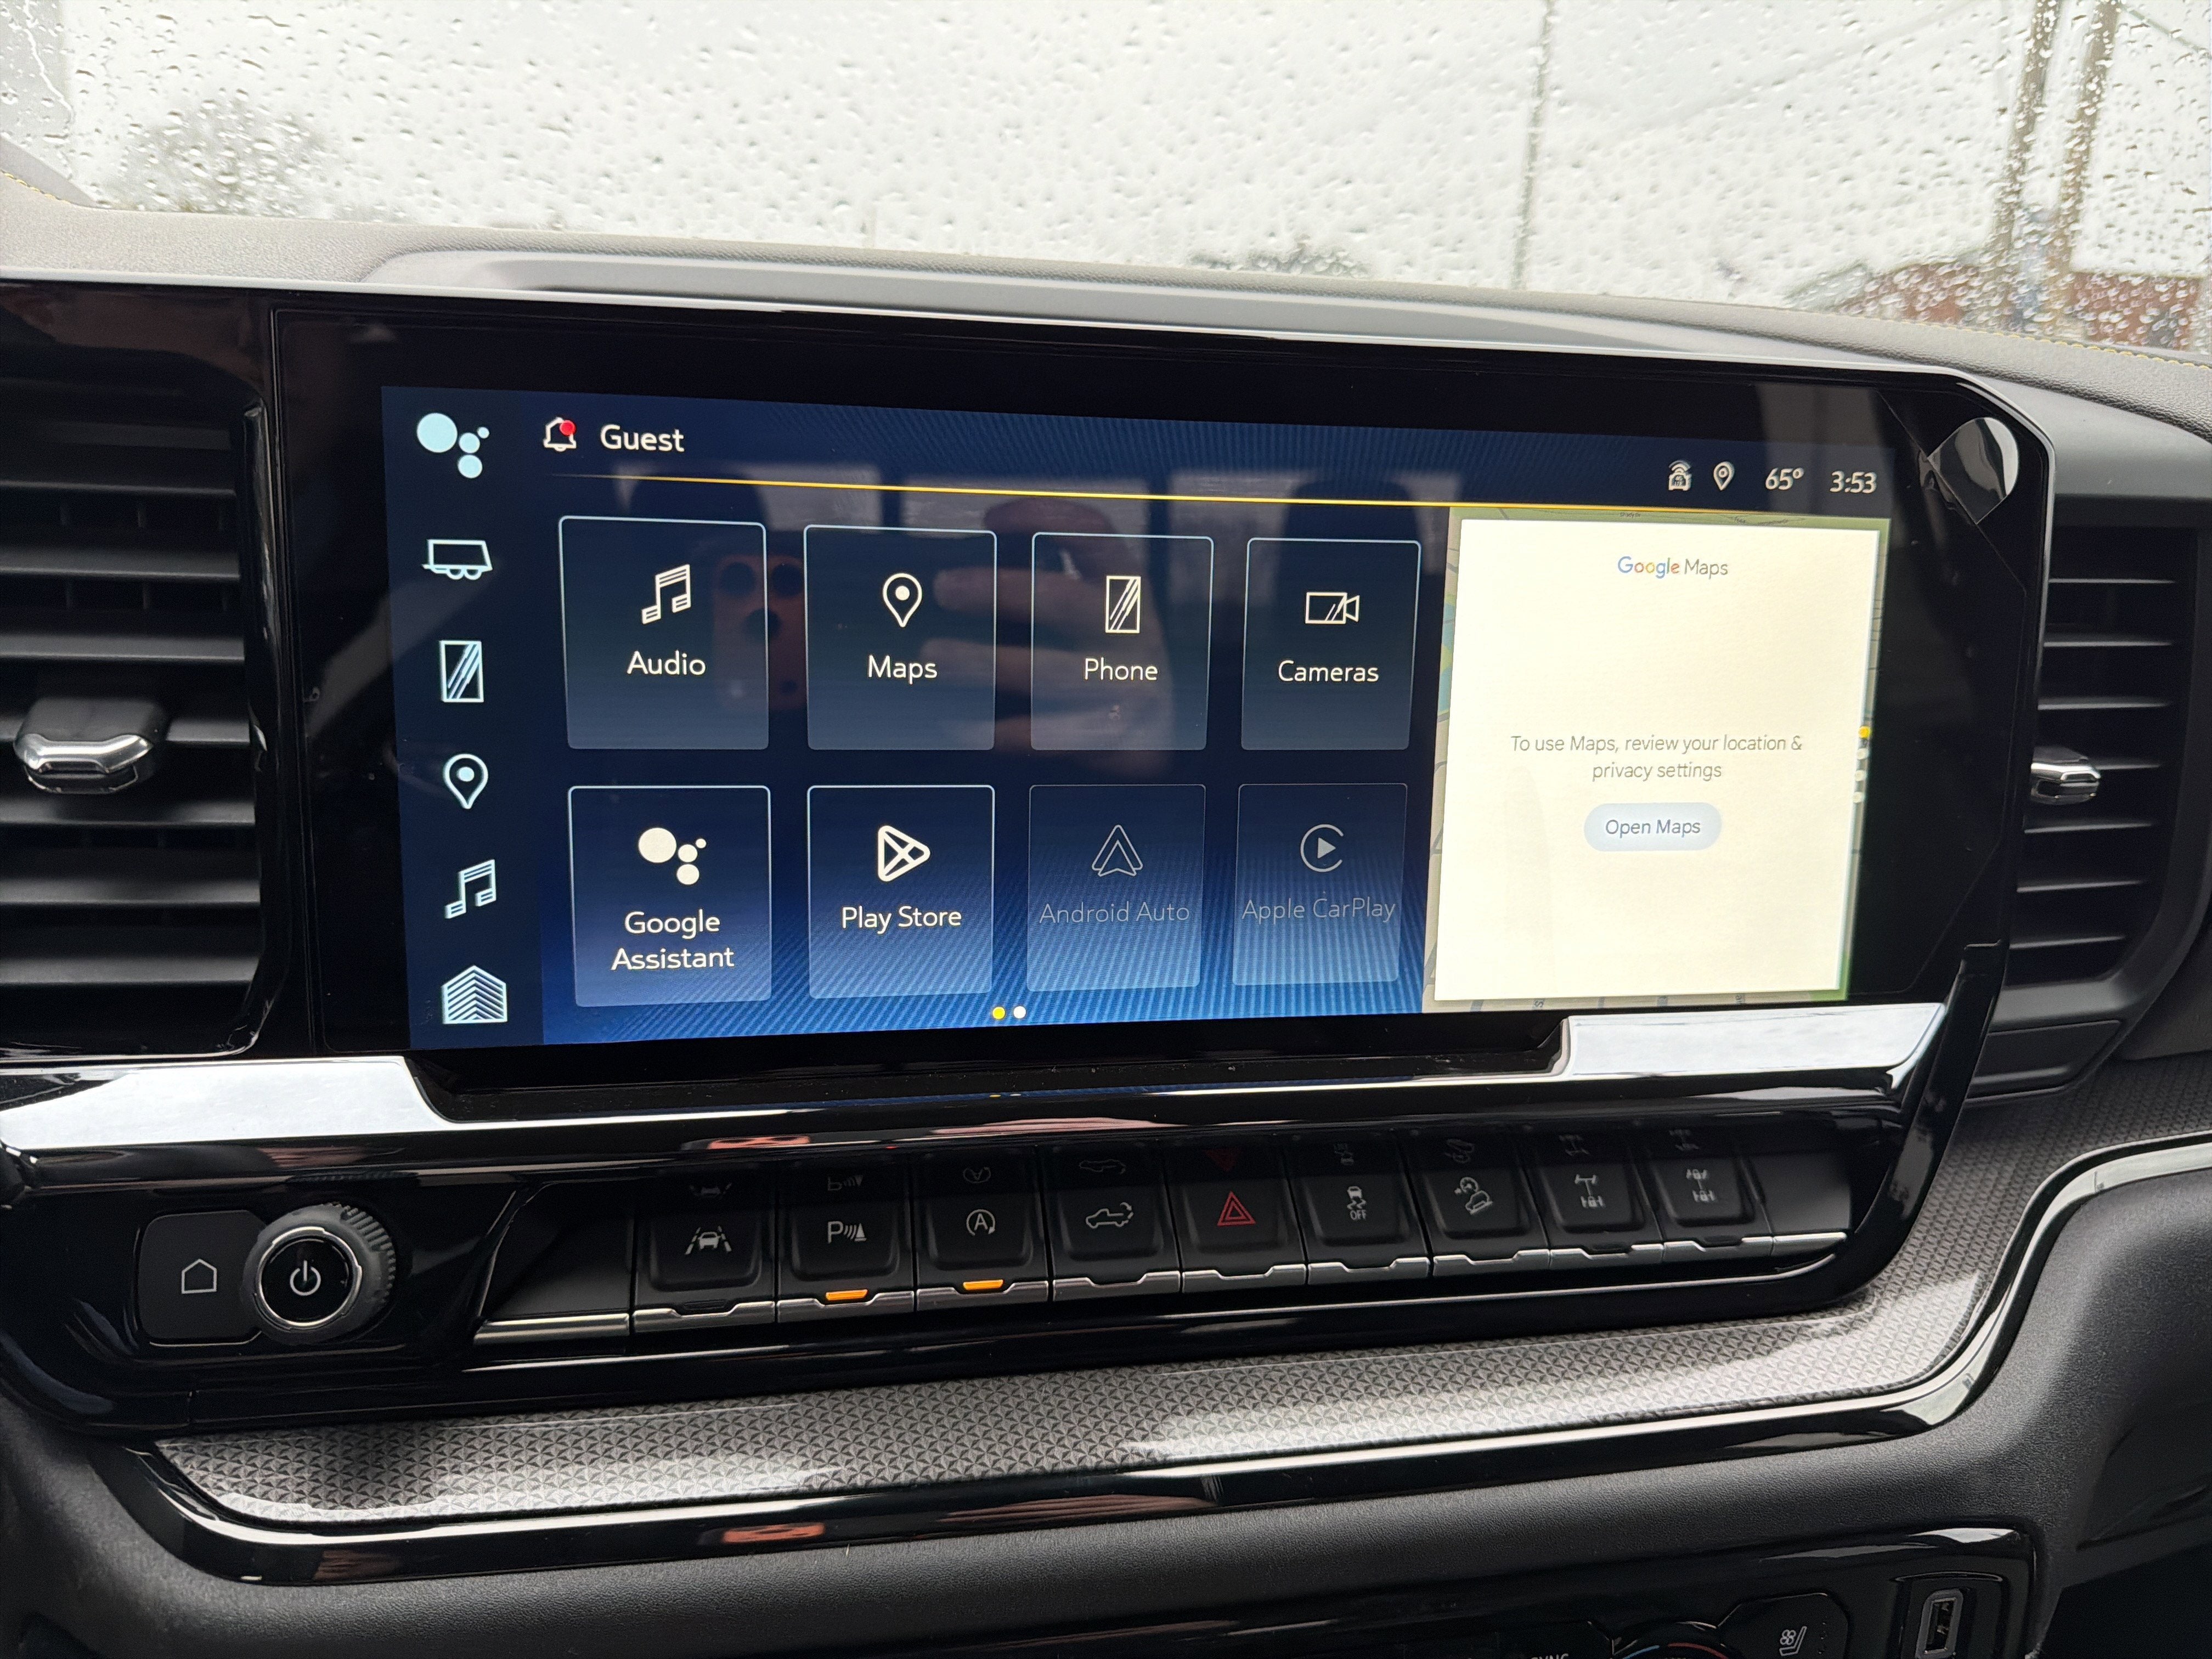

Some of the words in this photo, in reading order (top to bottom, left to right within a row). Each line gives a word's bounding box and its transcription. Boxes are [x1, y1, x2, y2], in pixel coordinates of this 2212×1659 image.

[600, 424, 685, 453] Guest
[1764, 467, 1804, 491] 65°
[1829, 470, 1877, 494] 3:53
[1617, 555, 1680, 580] Google
[1684, 557, 1729, 580] Maps
[626, 650, 707, 676] Audio
[867, 654, 938, 685] Maps
[1084, 656, 1159, 681] Phone
[1278, 659, 1380, 682] Cameras
[1510, 735, 1531, 752] To
[1534, 738, 1565, 752] use
[1570, 735, 1620, 755] Maps,
[1624, 733, 1679, 752] review
[1681, 738, 1719, 755] your
[1723, 733, 1787, 751] location
[1790, 735, 1803, 751] &
[1592, 760, 1654, 783] privacy
[1656, 760, 1722, 782] settings
[1605, 819, 1652, 839] Open
[1655, 819, 1701, 838] Maps
[841, 905, 893, 935] Play
[898, 905, 962, 928] Store
[1039, 900, 1130, 924] Android
[1135, 901, 1190, 922] Auto
[1240, 897, 1306, 927] Apple
[1312, 895, 1397, 924] CarPlay
[624, 908, 721, 940] Google
[610, 946, 735, 972] Assistant
[1350, 1209, 1367, 1220] OFF
[827, 1221, 844, 1244] P
